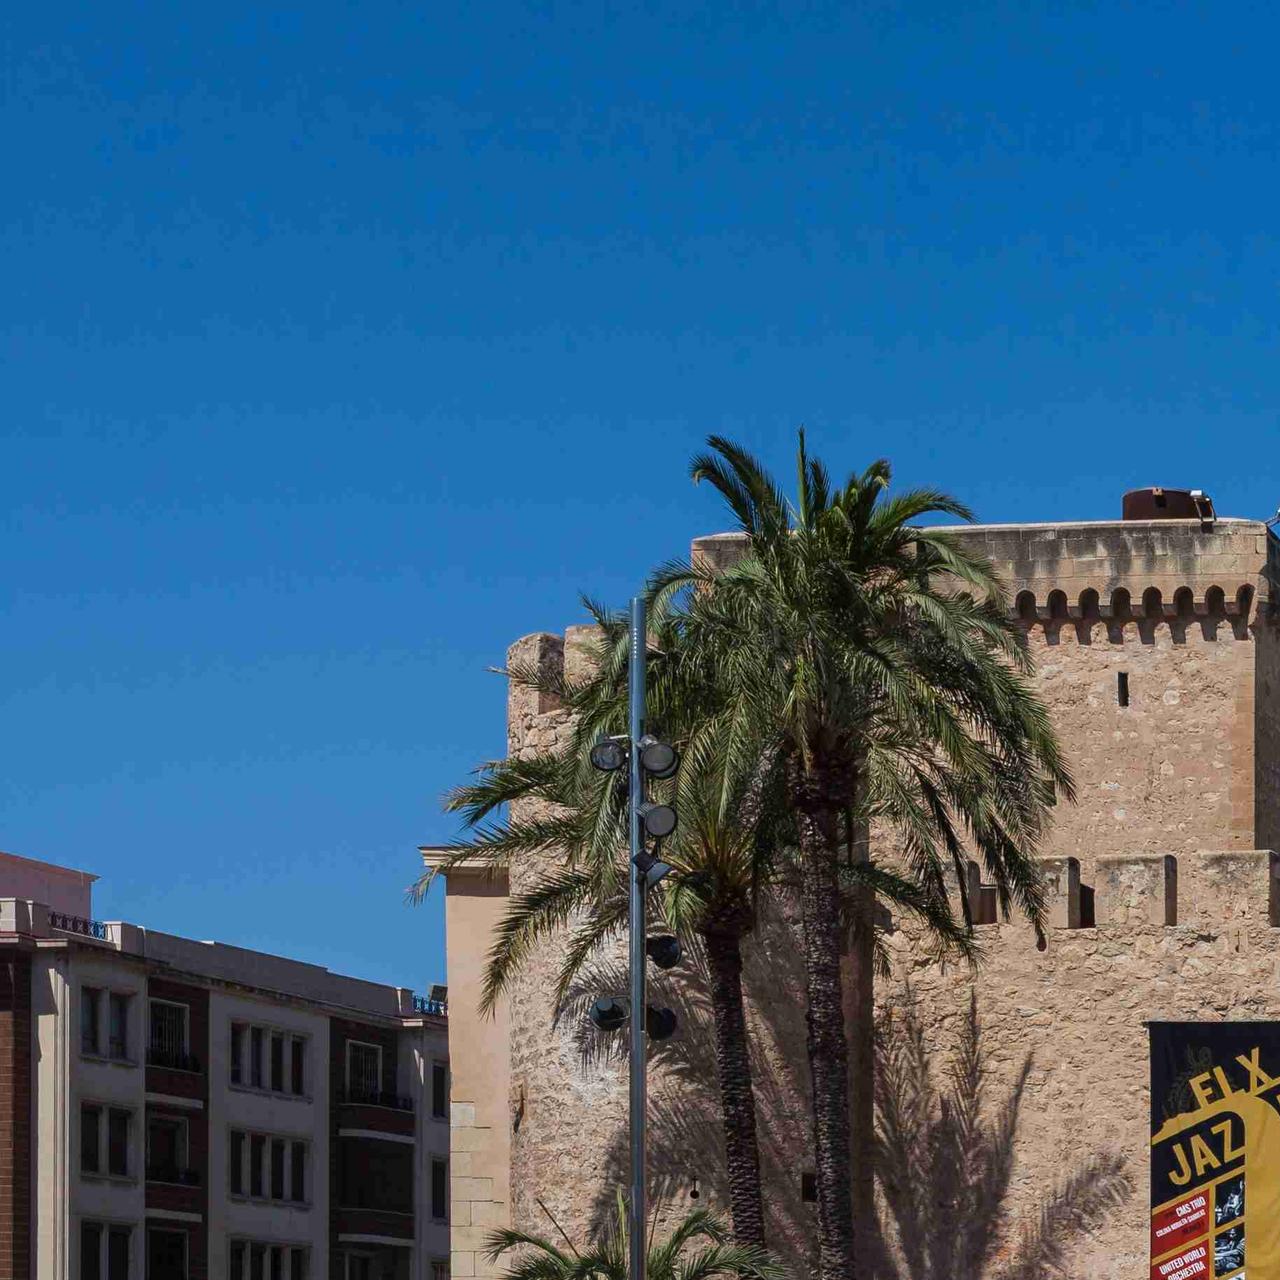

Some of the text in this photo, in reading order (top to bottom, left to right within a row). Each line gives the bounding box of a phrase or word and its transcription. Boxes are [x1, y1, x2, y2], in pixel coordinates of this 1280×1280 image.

[1176, 1196, 1206, 1217] CMS TRIO
[1159, 1247, 1206, 1275] UNITED WORLD
